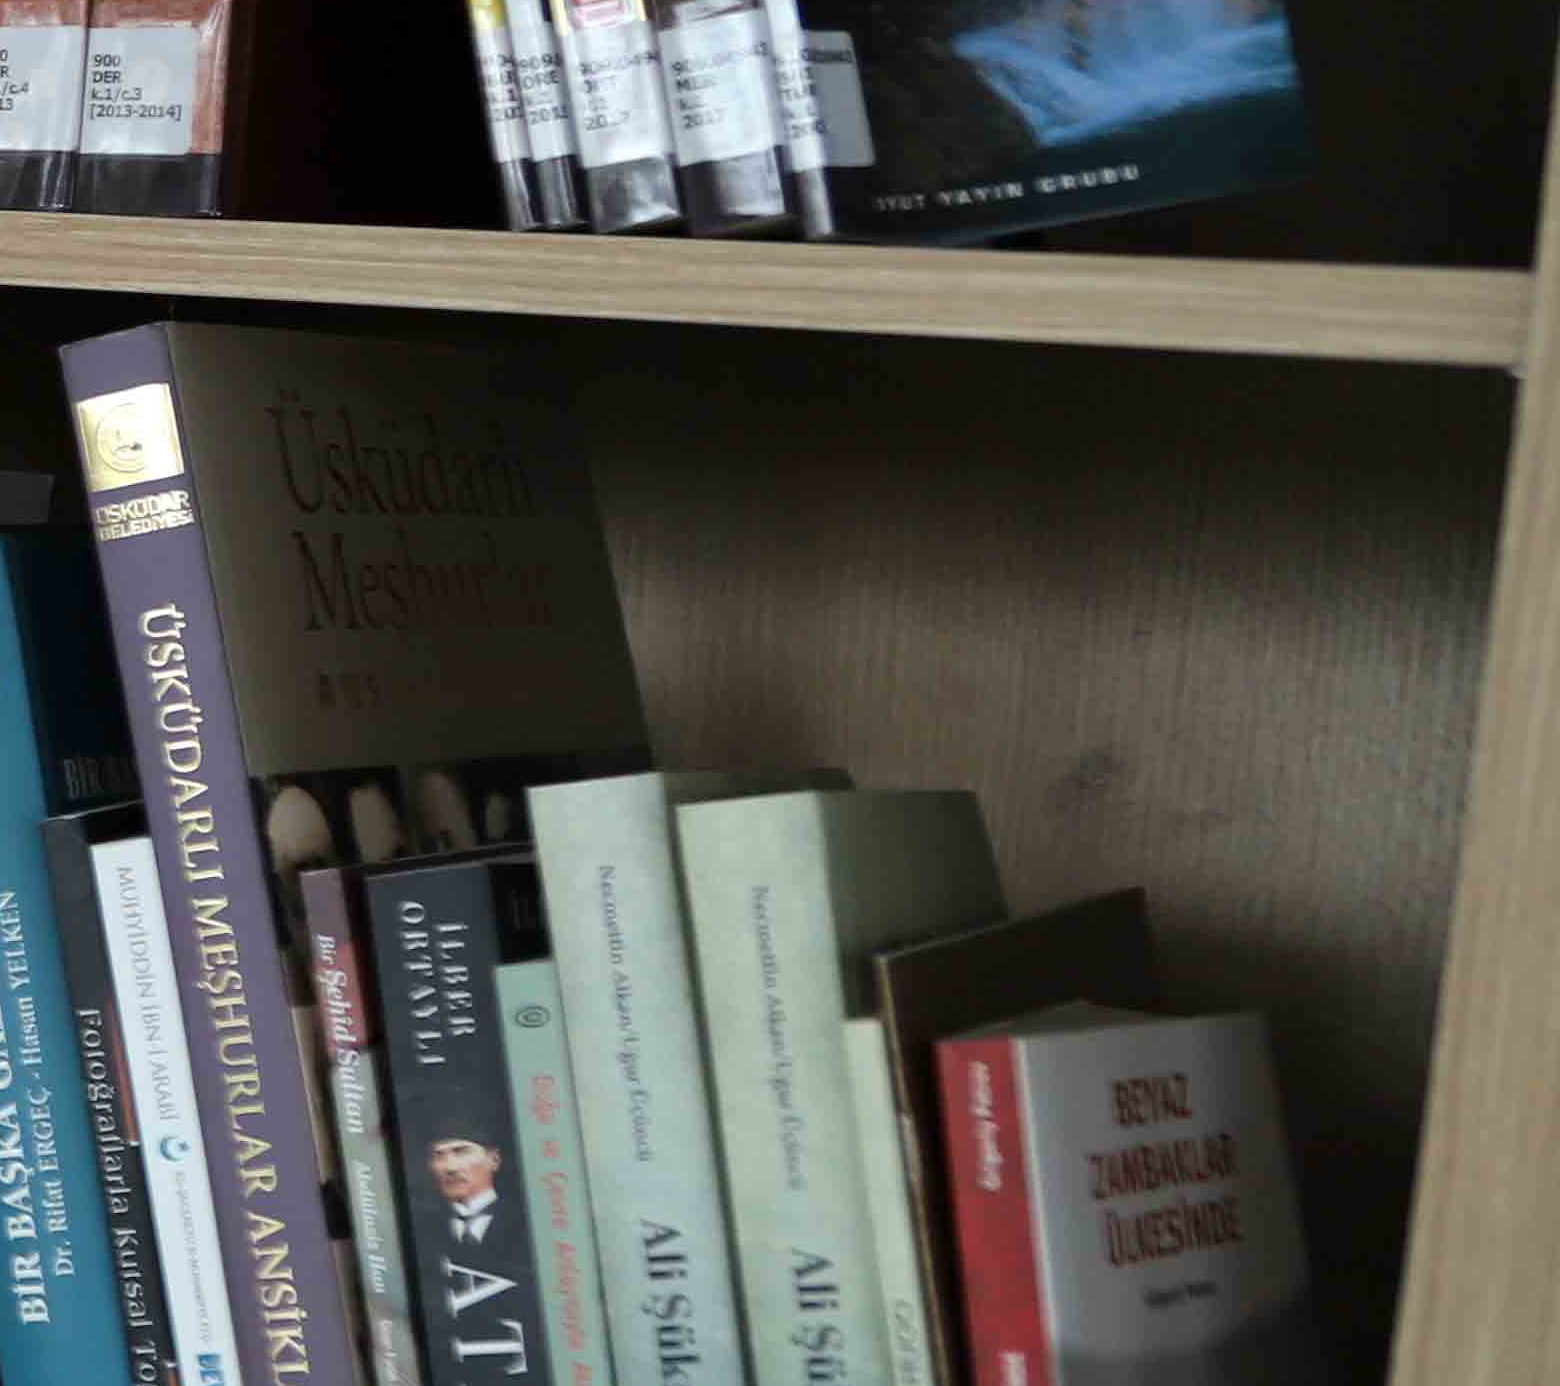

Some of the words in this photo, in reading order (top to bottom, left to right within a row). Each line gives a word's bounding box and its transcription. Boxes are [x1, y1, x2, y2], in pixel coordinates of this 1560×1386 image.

[92, 70, 120, 83] DER
[94, 54, 120, 67] 900
[96, 490, 190, 528] ÜSKÜDAR
[138, 602, 224, 884] ÜSKÜDARLI
[189, 895, 277, 1200] MEŞHURLAR
[2, 891, 31, 989] YELKEN
[398, 899, 446, 1068] ORTAYLI
[432, 922, 477, 1038] İLBER
[1111, 1073, 1193, 1128] BEYAZ
[78, 1008, 131, 1215] Fotoğraflarla
[111, 1225, 153, 1328] Kutsal
[1087, 1133, 1238, 1201] ZAMBAKLAR
[14, 1248, 51, 1324] BİR
[54, 1240, 77, 1277] Dr.
[640, 1219, 685, 1284] Ali
[792, 1247, 837, 1318] Ali
